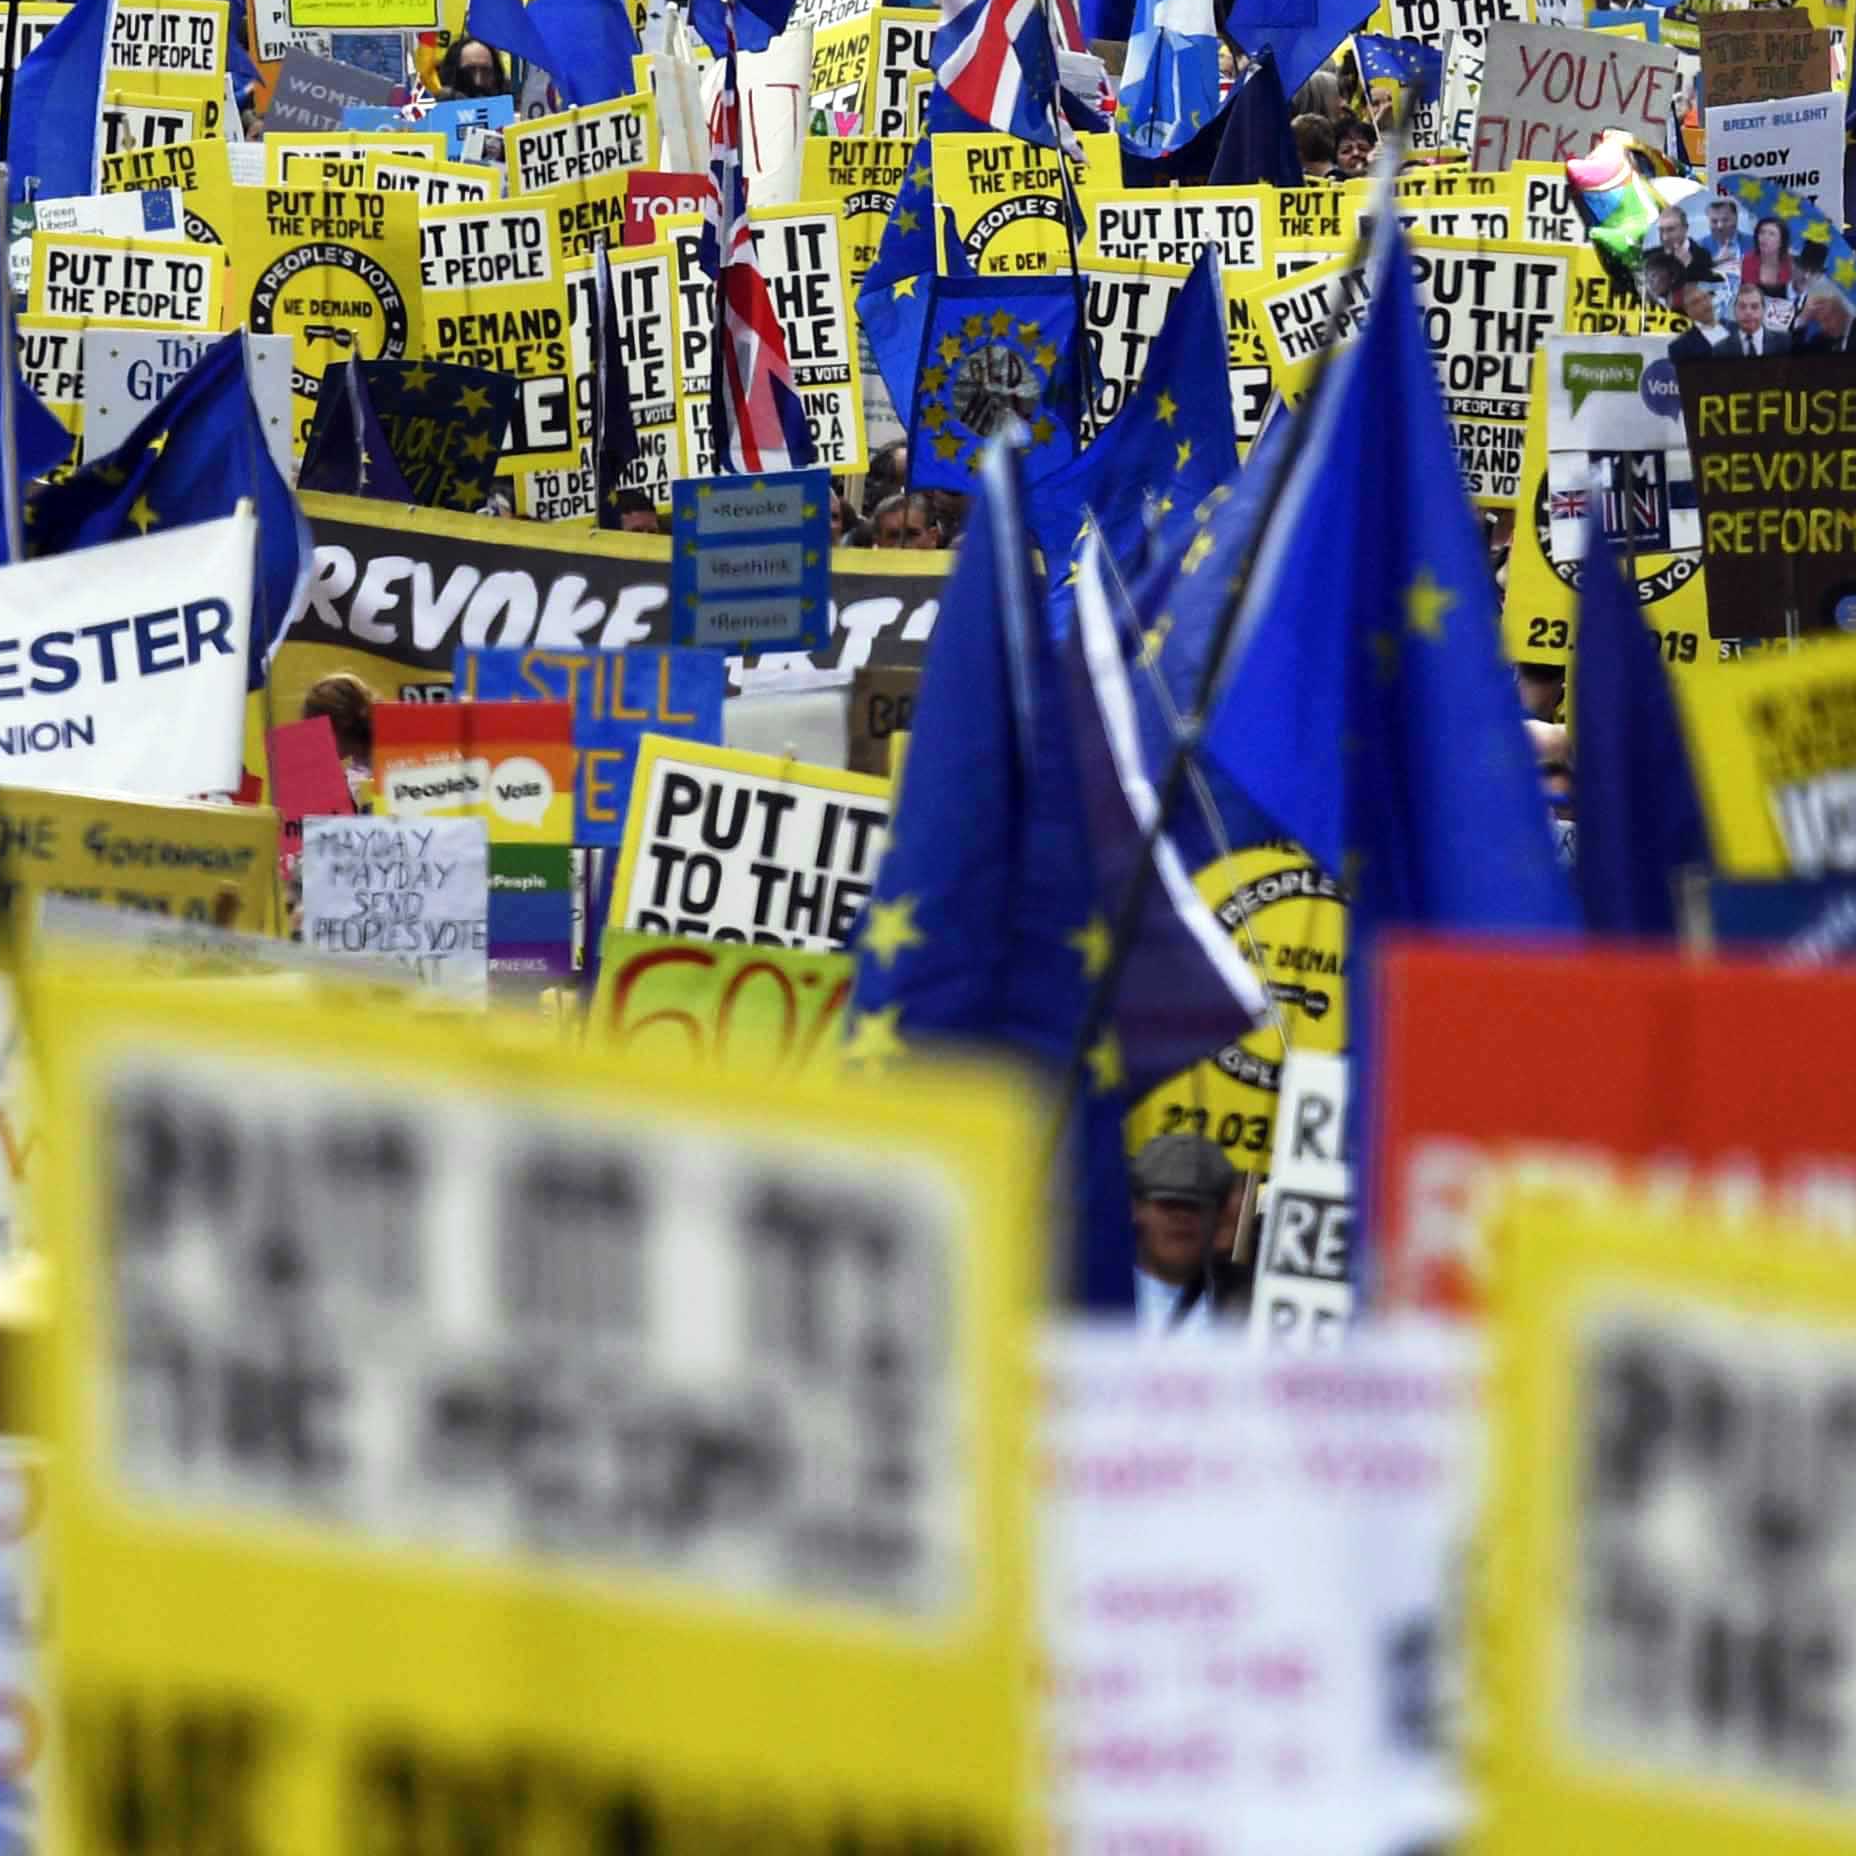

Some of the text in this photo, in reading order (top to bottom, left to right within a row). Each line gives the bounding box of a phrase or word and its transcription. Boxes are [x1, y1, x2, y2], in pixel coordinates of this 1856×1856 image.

[1722, 106, 1831, 132] BREXIT BULLSHIT
[1717, 148, 1791, 173] BLOODY
[266, 190, 385, 216] PUT IT TO
[1099, 206, 1255, 239] PUT IT TO
[48, 252, 204, 292] PUT IT TO
[48, 287, 203, 322] THE PEOPLE
[283, 299, 373, 319] WE DEMAND
[438, 308, 562, 347] DEMAND
[1568, 363, 1637, 386] People's
[1454, 398, 1523, 418] PEOPLE'S
[290, 544, 670, 649] REVOKE
[519, 653, 695, 723] STILL
[393, 775, 542, 805] People's Vote
[655, 774, 886, 870] PUT IT
[317, 829, 433, 858] MAYDAY
[332, 862, 458, 888] MAYDAY
[353, 894, 423, 919] SEND
[649, 846, 860, 939] TO THE
